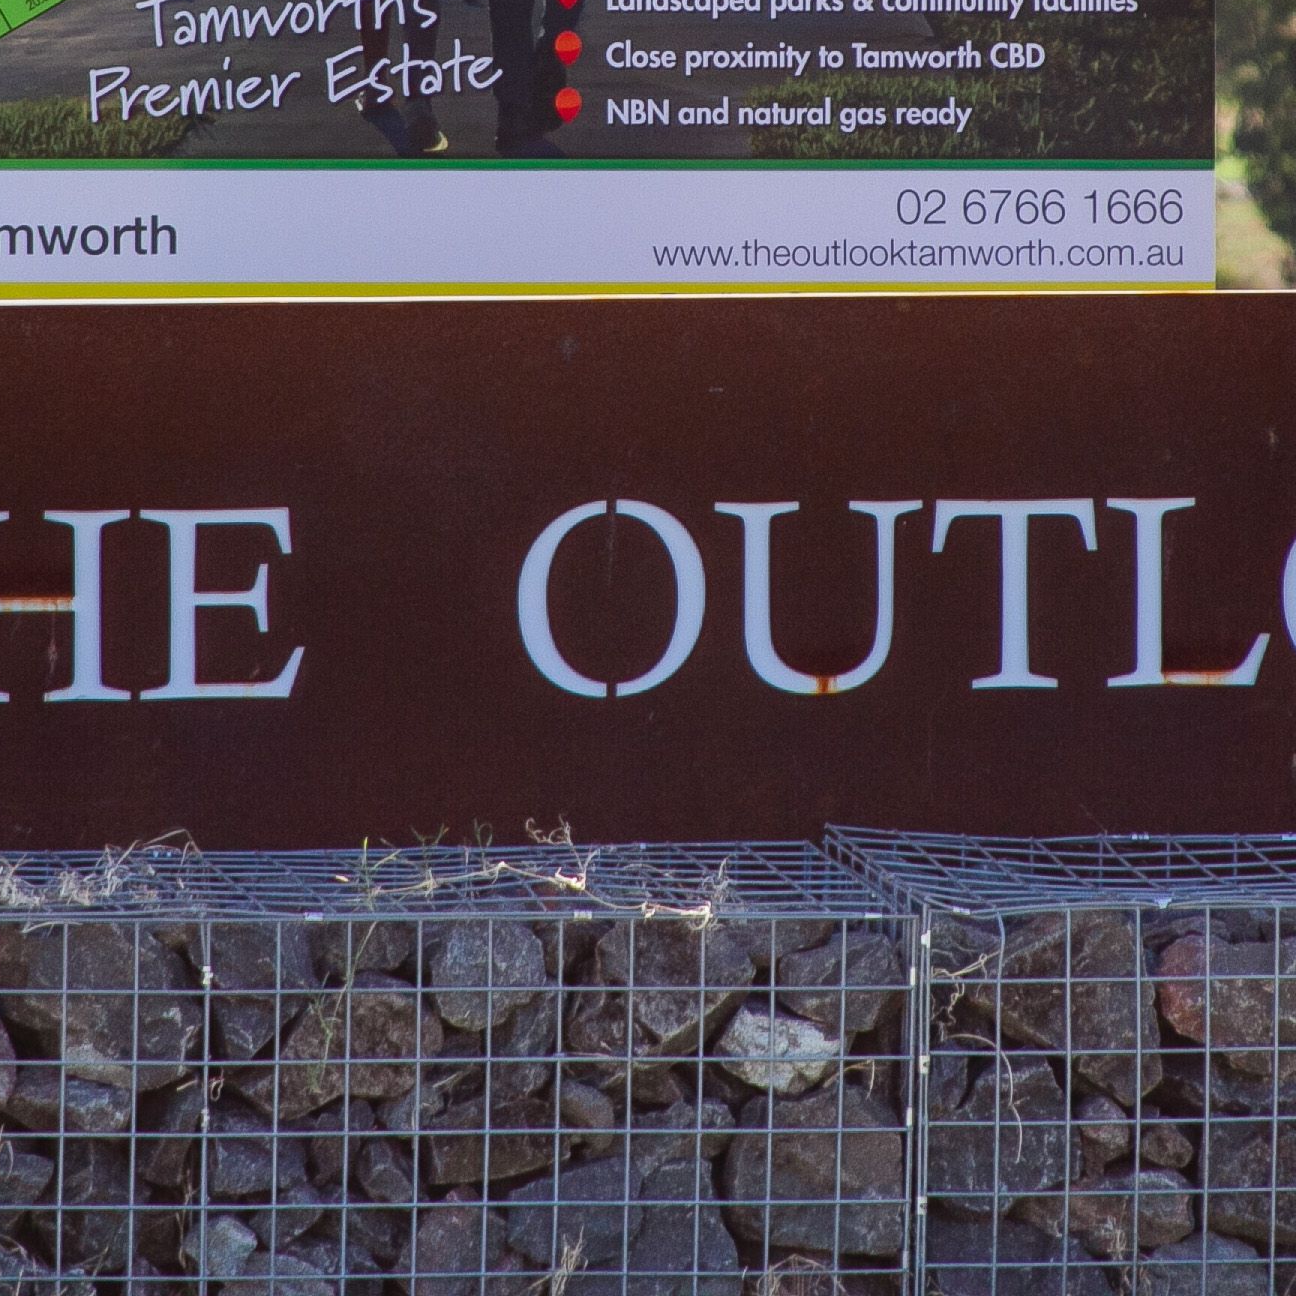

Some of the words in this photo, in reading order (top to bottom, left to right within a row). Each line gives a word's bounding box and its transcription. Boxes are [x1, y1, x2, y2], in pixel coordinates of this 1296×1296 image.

[605, 39, 676, 69] Close
[685, 42, 811, 76] proximity
[819, 46, 844, 69] to
[852, 40, 982, 69] Tamworth
[990, 42, 1046, 69] CBD
[89, 56, 301, 123] Premier
[326, 38, 504, 103] Estate
[607, 99, 670, 125] NBN
[678, 96, 729, 125] and
[738, 97, 831, 125] natural
[839, 107, 887, 133] gas
[895, 97, 973, 133] ready
[896, 190, 947, 225] 02
[963, 190, 1066, 225] 6766
[1083, 190, 1184, 225] 1666
[653, 238, 1184, 269] www.theoutlooktamworth.com.au
